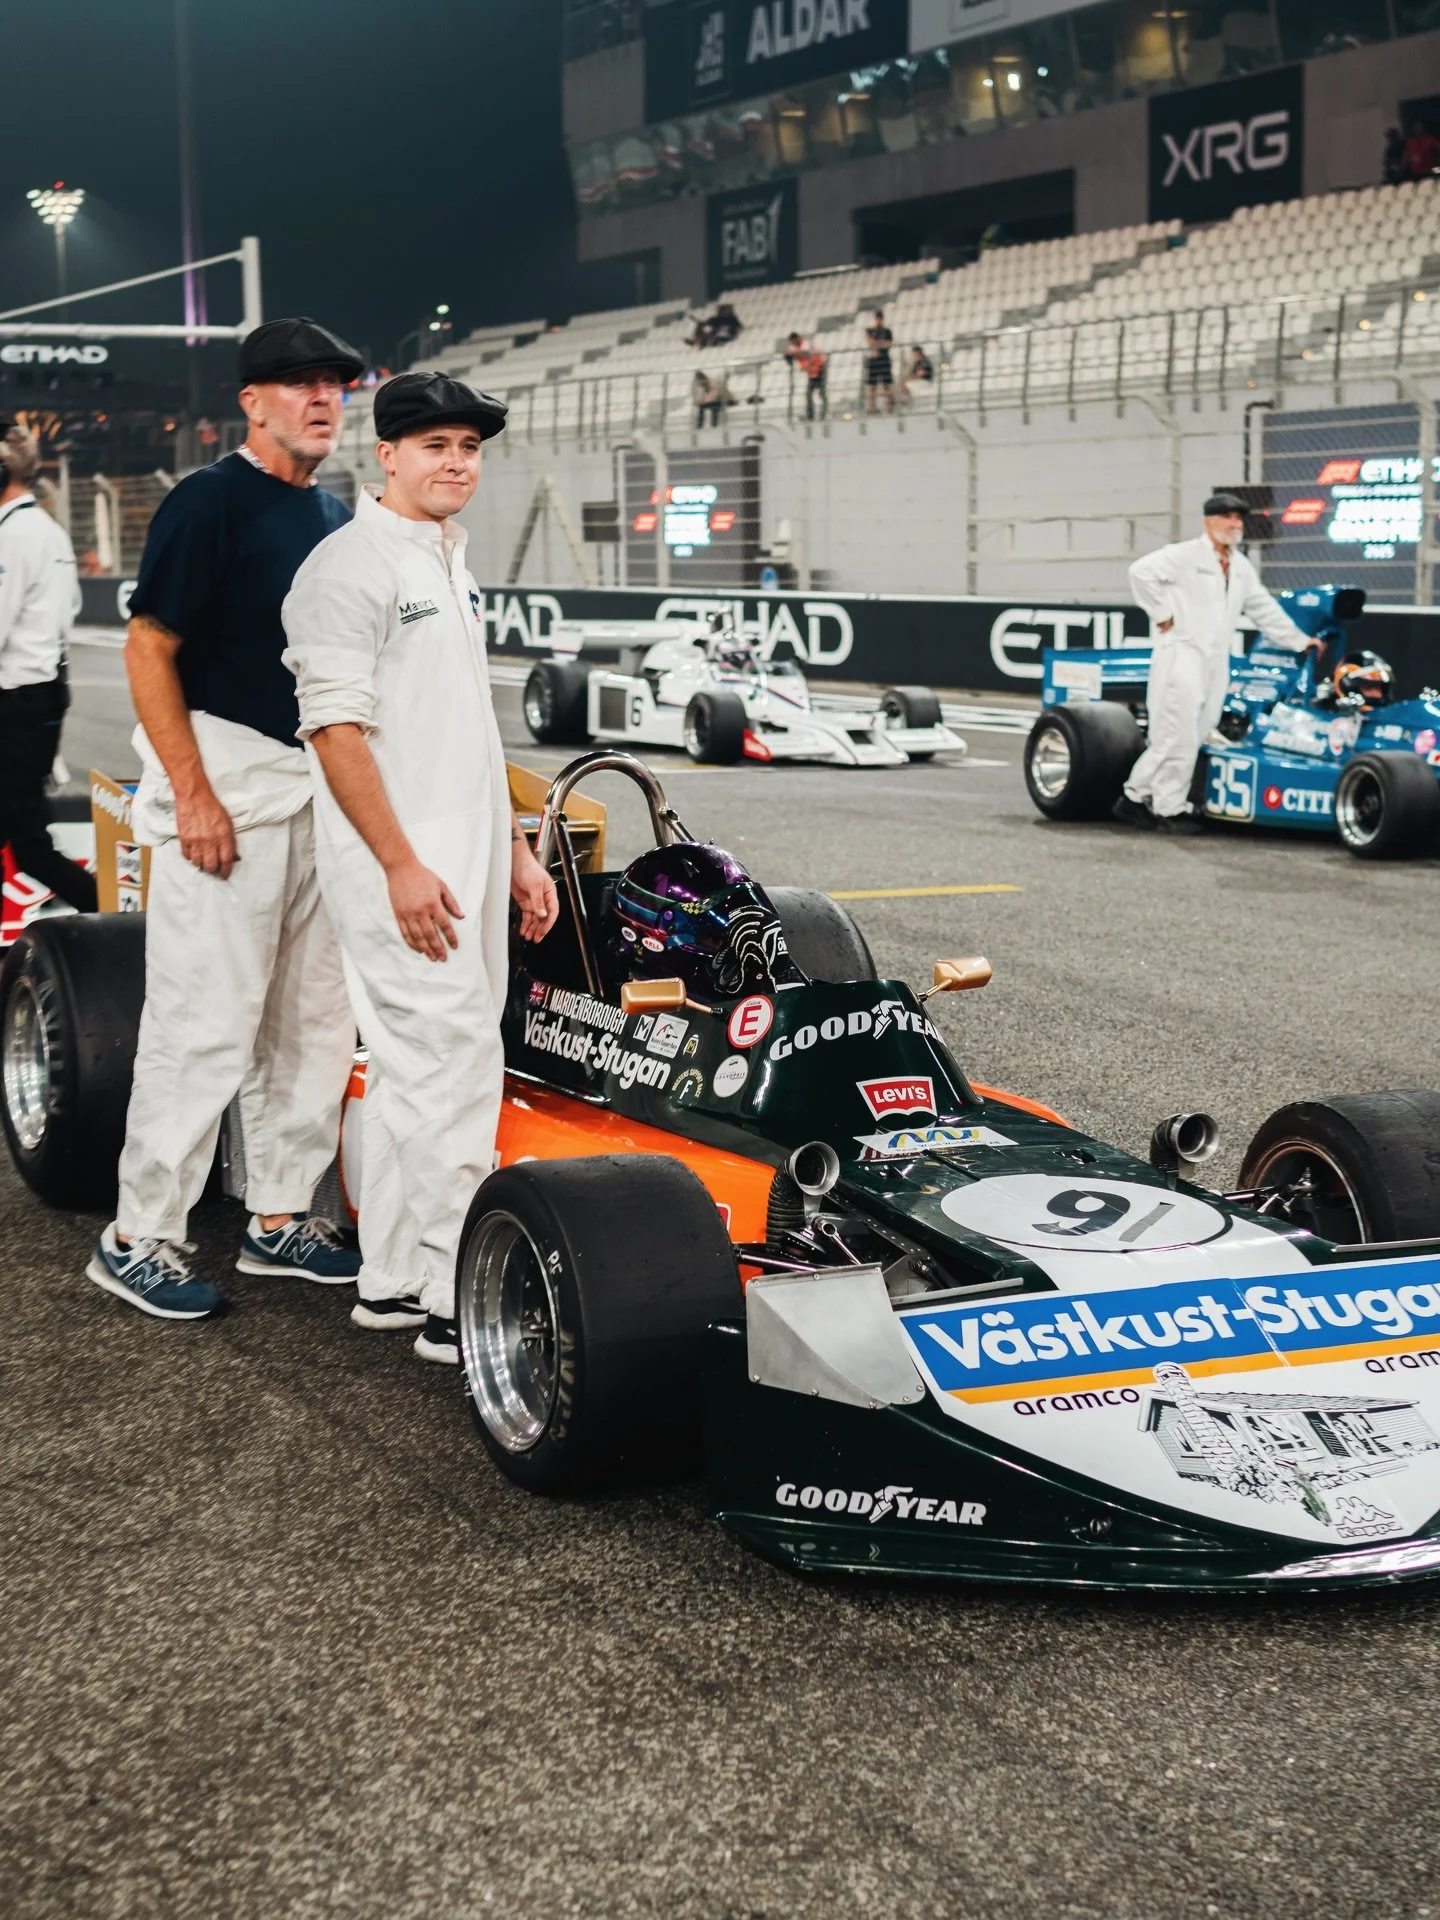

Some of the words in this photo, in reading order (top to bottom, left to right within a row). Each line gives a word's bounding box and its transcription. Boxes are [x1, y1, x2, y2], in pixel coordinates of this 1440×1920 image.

[746, 0, 870, 63] ALDAR
[1161, 110, 1290, 186] XRG
[0, 344, 108, 364] ETIHAD
[631, 696, 643, 727] 6
[1207, 755, 1252, 818] 35
[549, 987, 629, 1036] MARDENBOROUGH
[634, 1016, 654, 1040] M
[738, 1004, 763, 1037] E
[524, 1009, 672, 1090] Västkust-Stugan
[679, 1080, 694, 1100] F
[1013, 1387, 1140, 1416] aramco
[775, 1483, 987, 1525] GOODYEAR
